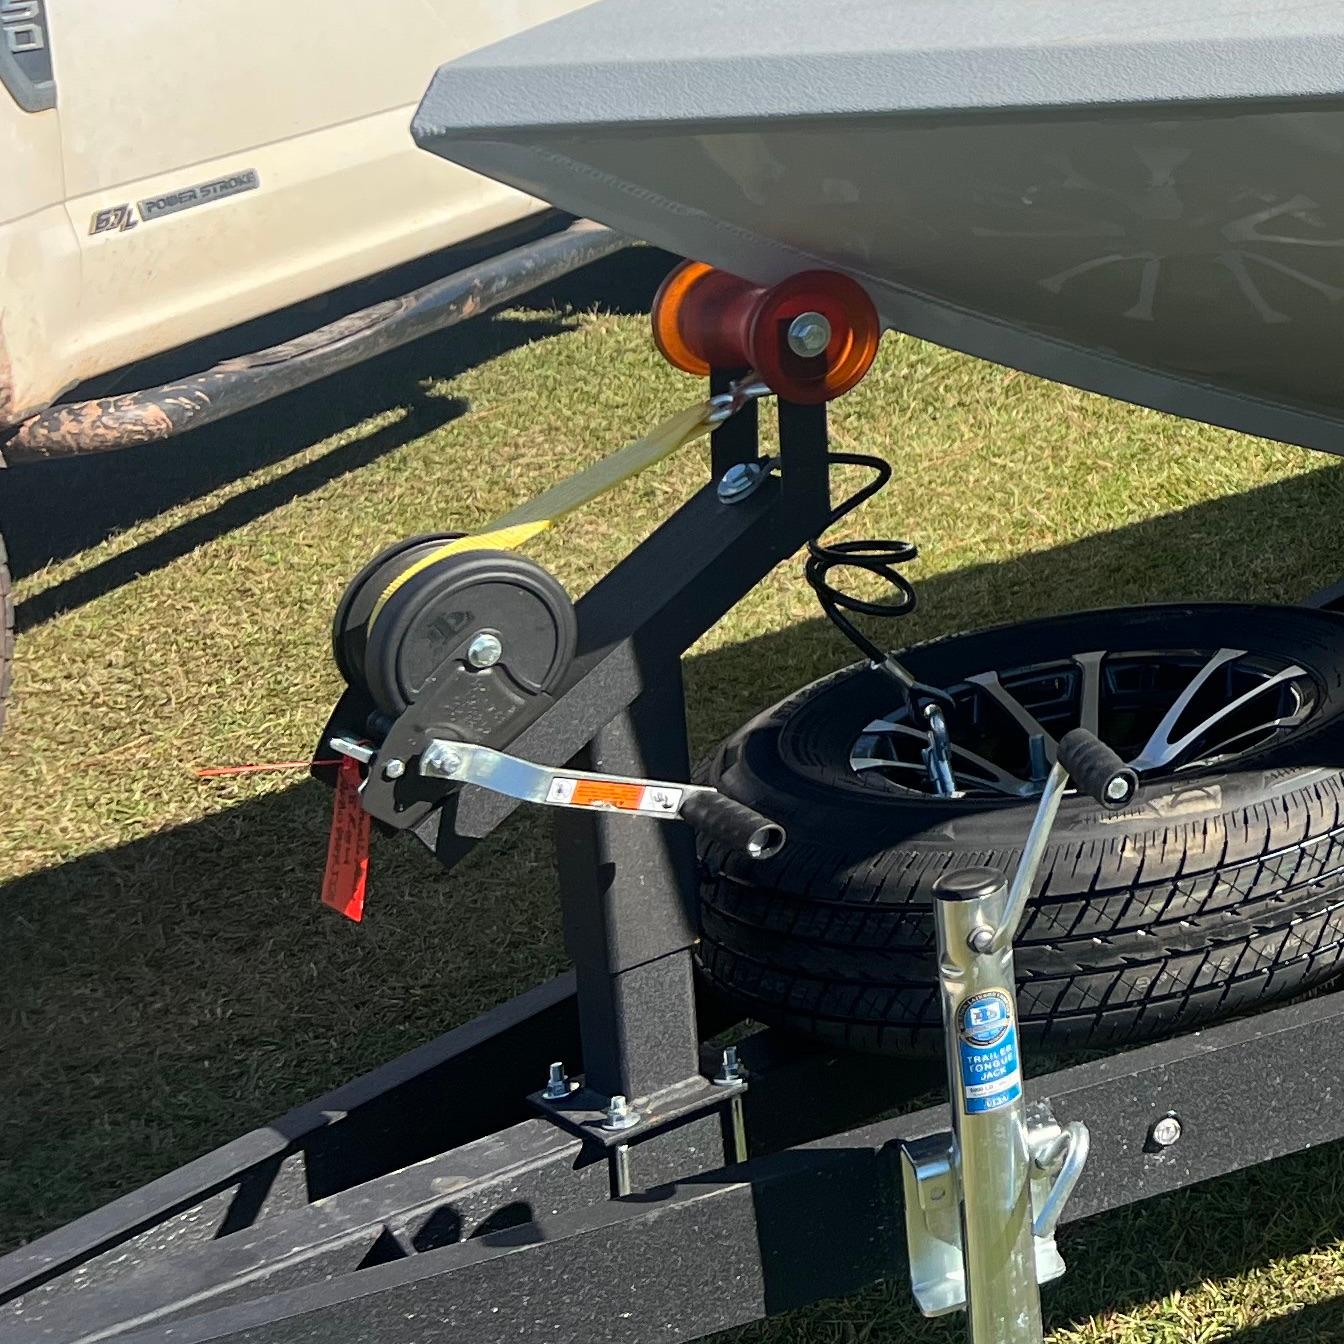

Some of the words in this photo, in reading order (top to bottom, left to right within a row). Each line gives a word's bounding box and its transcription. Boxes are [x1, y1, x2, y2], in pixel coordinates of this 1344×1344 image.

[145, 190, 198, 215] POWER
[200, 171, 258, 198] STROKE
[967, 1043, 1013, 1064] TRAILER
[968, 1052, 1013, 1073] TONGUE
[980, 1066, 1007, 1081] JACK
